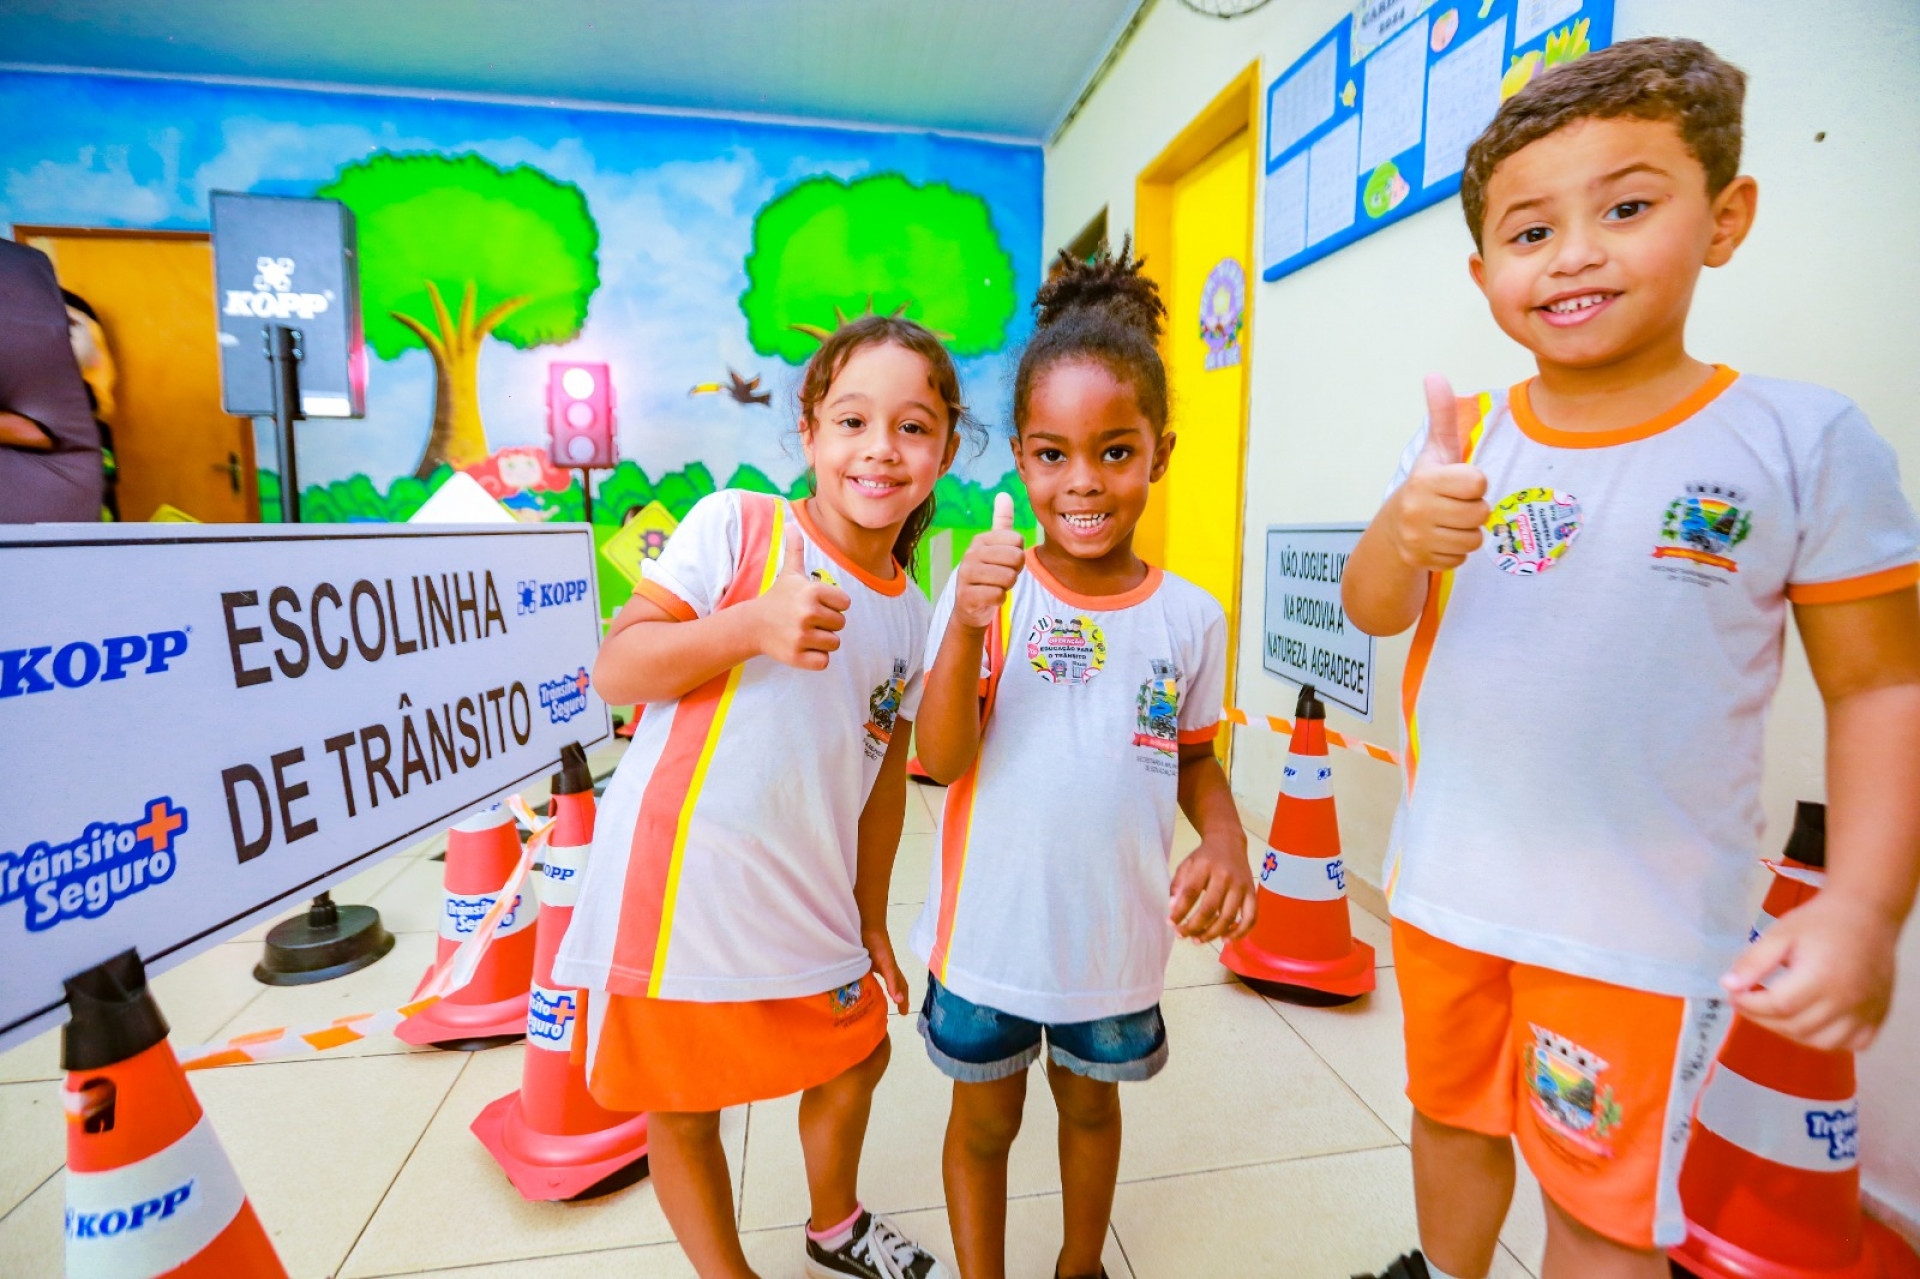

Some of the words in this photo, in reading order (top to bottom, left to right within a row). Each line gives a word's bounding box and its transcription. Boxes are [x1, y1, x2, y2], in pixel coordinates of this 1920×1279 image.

[223, 290, 329, 319] KOPP
[1299, 551, 1328, 582] JOGUE
[1331, 552, 1349, 584] LIX
[540, 579, 587, 607] KOPP
[1284, 593, 1295, 621] NA
[1296, 596, 1335, 633] RODOVIA
[1337, 604, 1344, 635] A
[221, 570, 507, 688] ESCOLINHA
[1267, 631, 1308, 671] NATUREZA
[1310, 645, 1365, 694] AGRADECE
[551, 693, 586, 722] Seguro
[221, 746, 318, 865] DE
[324, 681, 531, 818] TRÂNSITO
[35, 850, 171, 925] Seguro
[545, 864, 575, 881] OPP
[77, 1183, 194, 1239] KOPP
